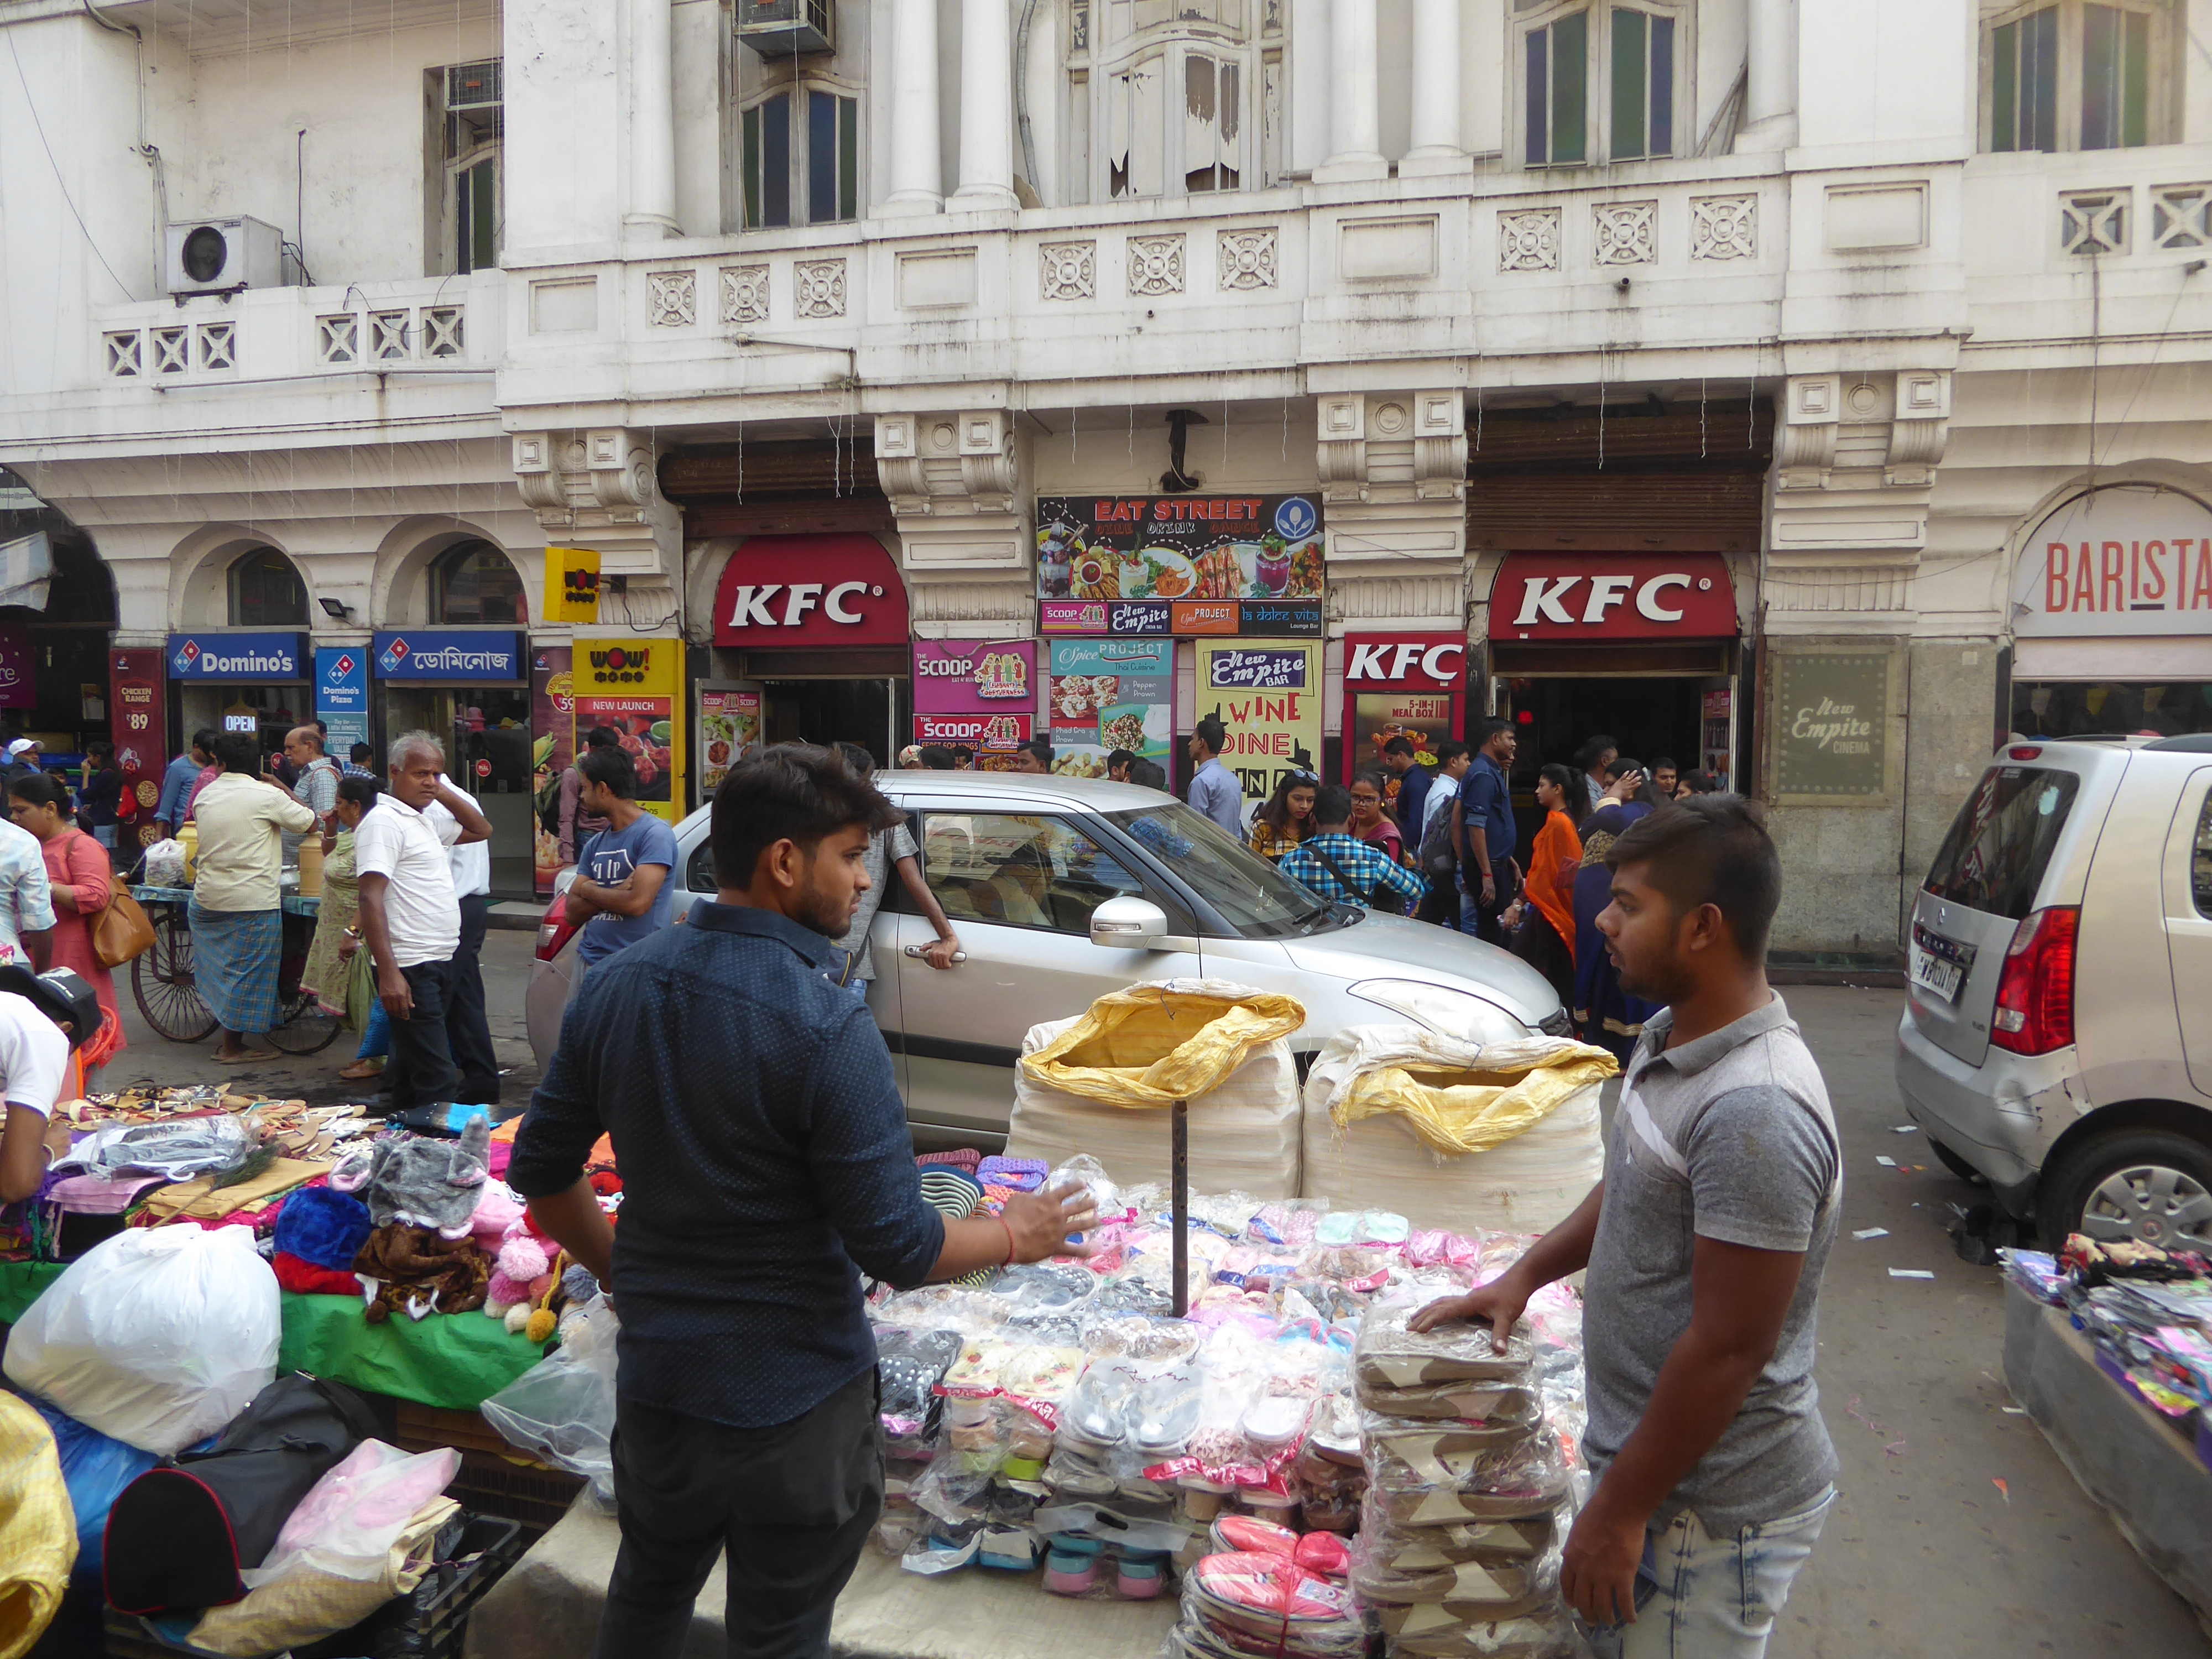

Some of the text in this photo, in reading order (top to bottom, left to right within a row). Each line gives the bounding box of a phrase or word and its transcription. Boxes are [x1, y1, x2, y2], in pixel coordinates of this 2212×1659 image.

[1095, 499, 1262, 521] EAT STREET
[1095, 521, 1260, 535] DINE DRINK DANCE
[2046, 539, 2212, 612] BARISTA
[729, 581, 867, 626] KFC
[1513, 573, 1691, 624] KFC
[1047, 609, 1078, 618] SCOOP
[1123, 604, 1146, 617] New
[1194, 608, 1230, 619] PROJECT
[1241, 606, 1319, 620] la dolce vita
[1112, 609, 1168, 633] Empire
[202, 650, 293, 672] Domino's
[412, 646, 510, 671] ডোমিনোজ
[1058, 644, 1163, 670] Spice PROJECT
[1229, 650, 1267, 667] New
[1346, 643, 1463, 680] KFC
[919, 659, 973, 676] SCOOP
[1115, 662, 1155, 671] Thai Cuisine
[1212, 658, 1305, 687] Empire
[1133, 680, 1156, 690] Pepper
[1265, 675, 1289, 686] BAR
[323, 686, 359, 695] Domino's
[331, 695, 352, 703] Pizza
[593, 701, 654, 710] NEW LAUNCH
[1409, 700, 1433, 708] 5-IN-1
[1817, 696, 1855, 716] New
[1228, 692, 1301, 724] WINE
[1392, 708, 1433, 718] MEAL BOX
[226, 715, 255, 731] OPEN
[924, 723, 982, 737] SCOOP
[1791, 707, 1870, 749] Empire
[328, 735, 356, 744] EVERYDAY
[1219, 733, 1290, 755] DINE
[334, 744, 351, 753] VALUE
[1833, 741, 1870, 754] CINEMA
